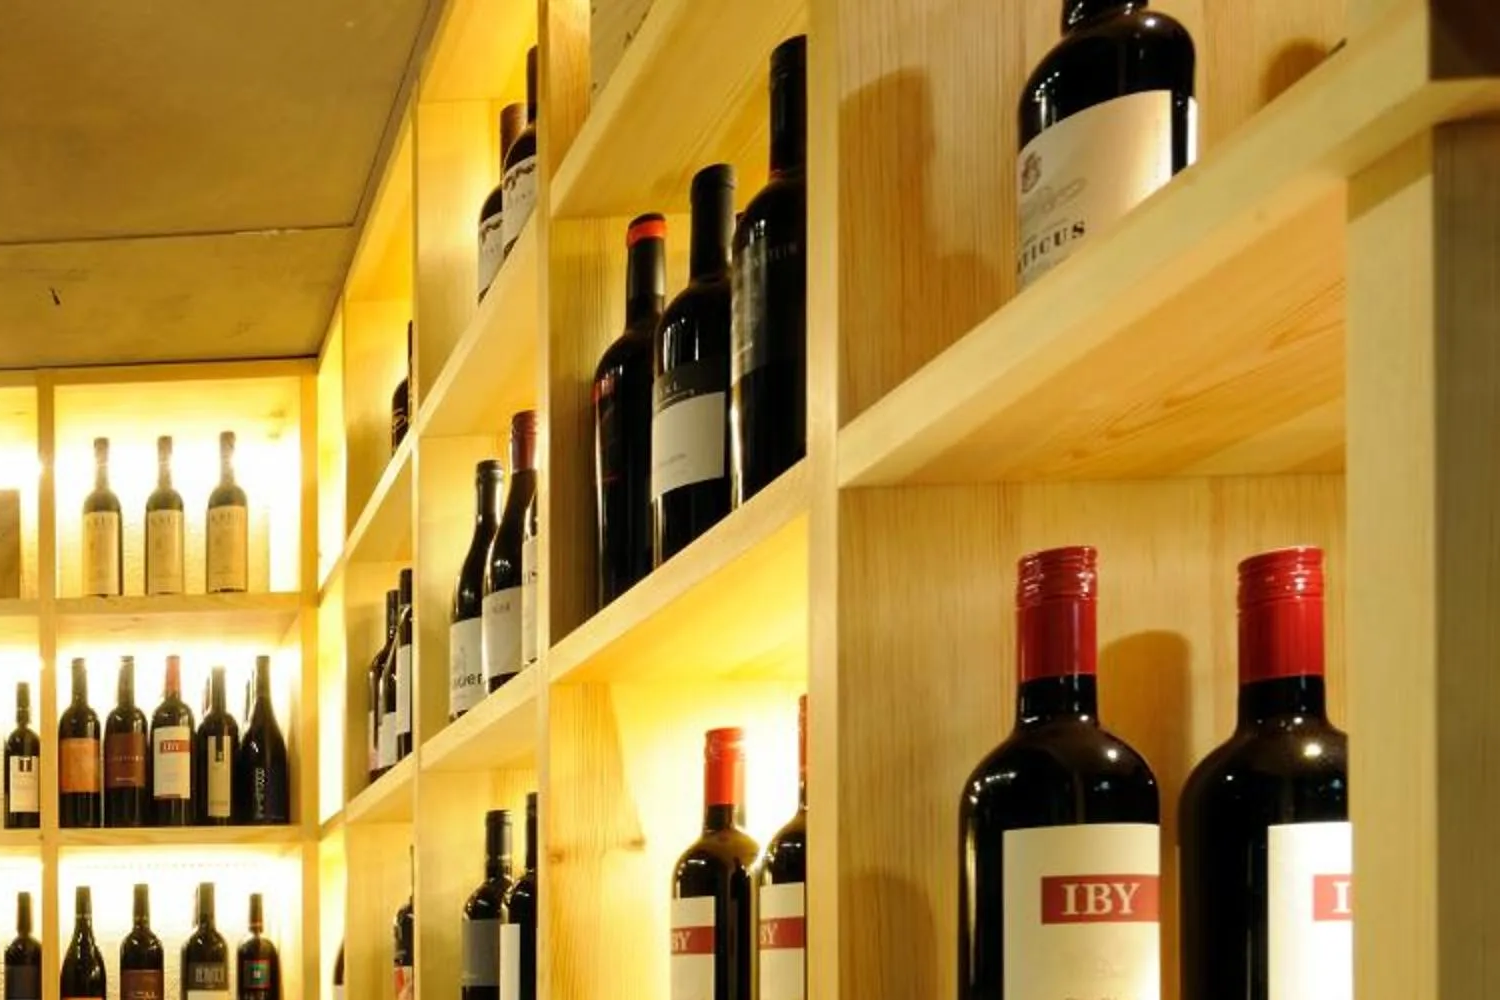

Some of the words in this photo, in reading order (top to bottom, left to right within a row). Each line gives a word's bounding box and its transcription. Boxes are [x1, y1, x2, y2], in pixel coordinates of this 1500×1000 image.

[1060, 882, 1141, 916] IBY
[672, 930, 691, 951] BY
[761, 923, 779, 945] BY
